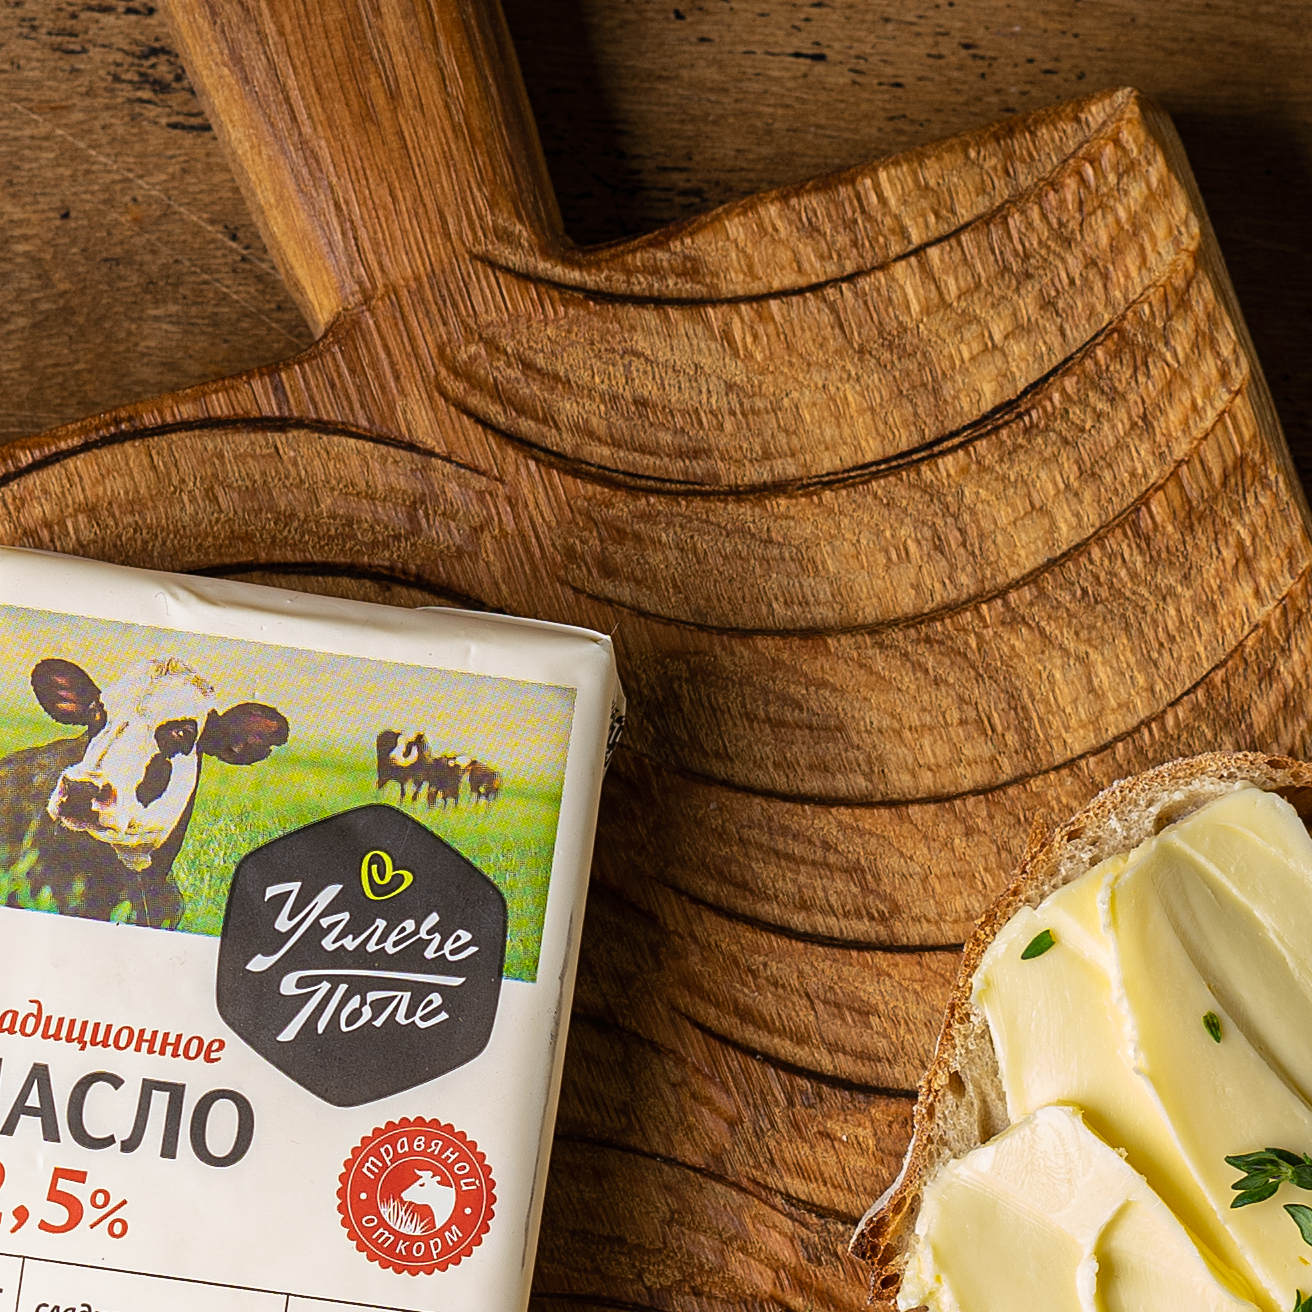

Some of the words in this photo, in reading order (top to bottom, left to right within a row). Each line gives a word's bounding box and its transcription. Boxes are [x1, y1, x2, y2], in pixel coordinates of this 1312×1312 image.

[245, 881, 479, 972] Углече
[276, 969, 466, 1042] Поле
[361, 1136, 480, 1190] травяной
[362, 1215, 462, 1259] откорм
